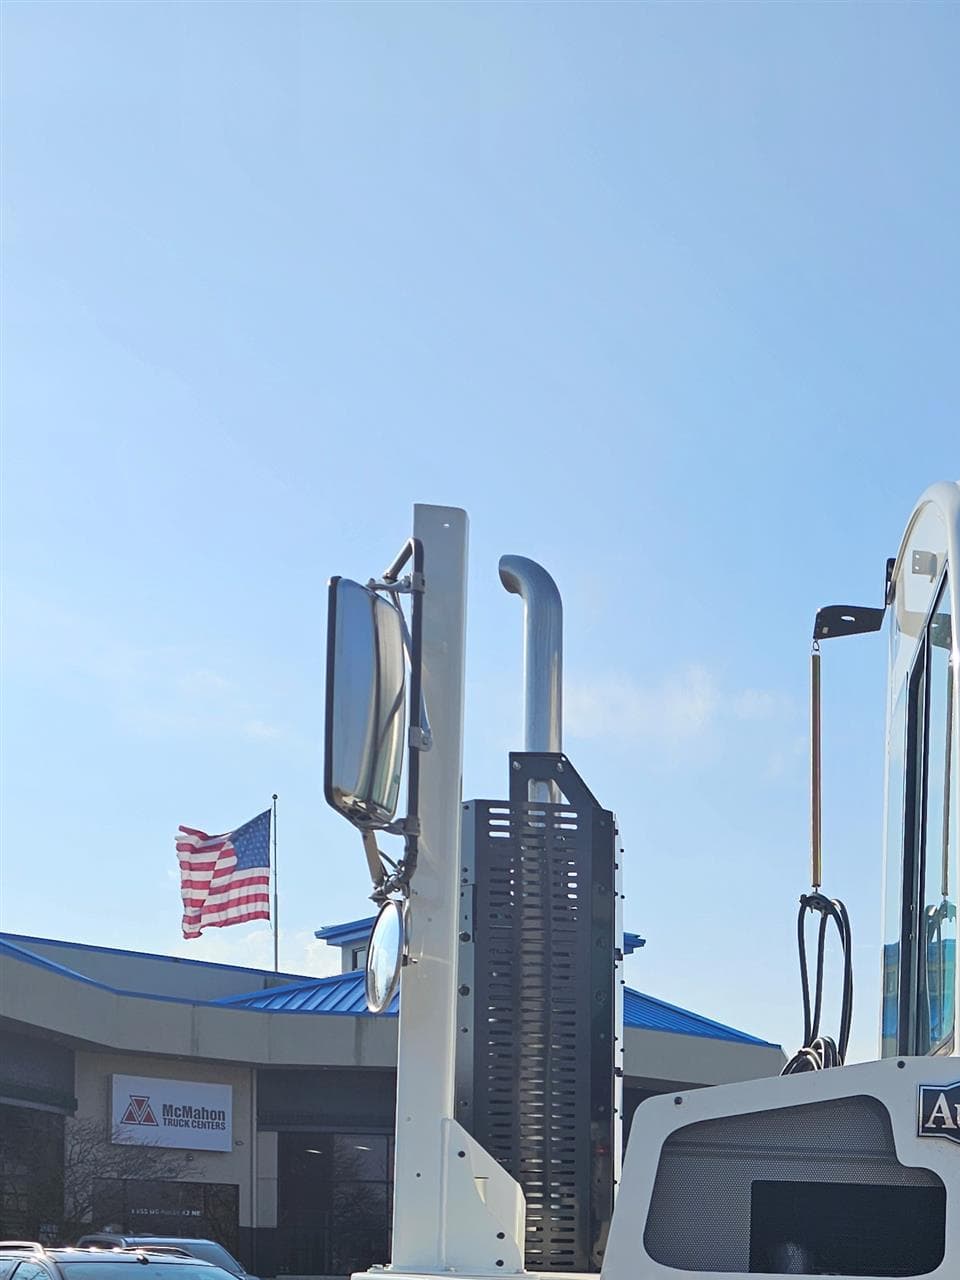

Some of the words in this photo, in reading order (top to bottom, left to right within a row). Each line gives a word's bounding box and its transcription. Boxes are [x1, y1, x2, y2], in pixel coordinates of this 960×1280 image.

[162, 1104, 226, 1121] McMahon
[163, 1118, 191, 1128] TRUCK
[191, 1120, 226, 1130] CENTERS
